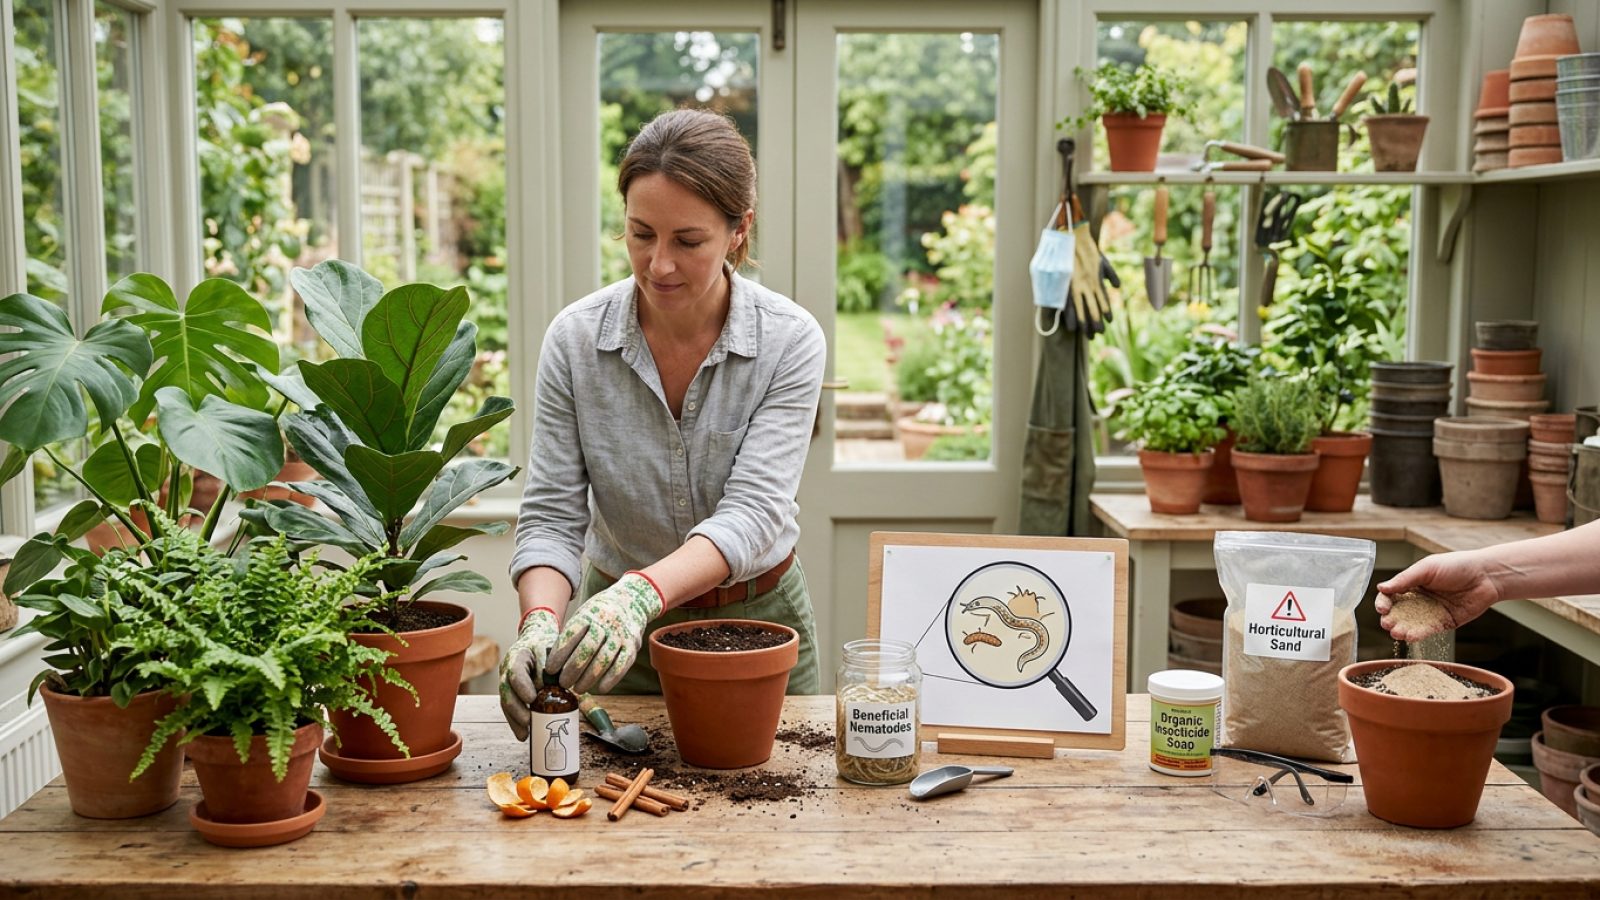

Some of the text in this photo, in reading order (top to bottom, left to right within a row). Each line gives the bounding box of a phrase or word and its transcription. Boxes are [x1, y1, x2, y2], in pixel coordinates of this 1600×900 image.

[1248, 622, 1325, 639] Horticultural
[1270, 638, 1301, 652] Sand
[853, 708, 908, 721] Beneficial
[850, 721, 912, 734] Nematodes
[1167, 737, 1195, 752] Soap
